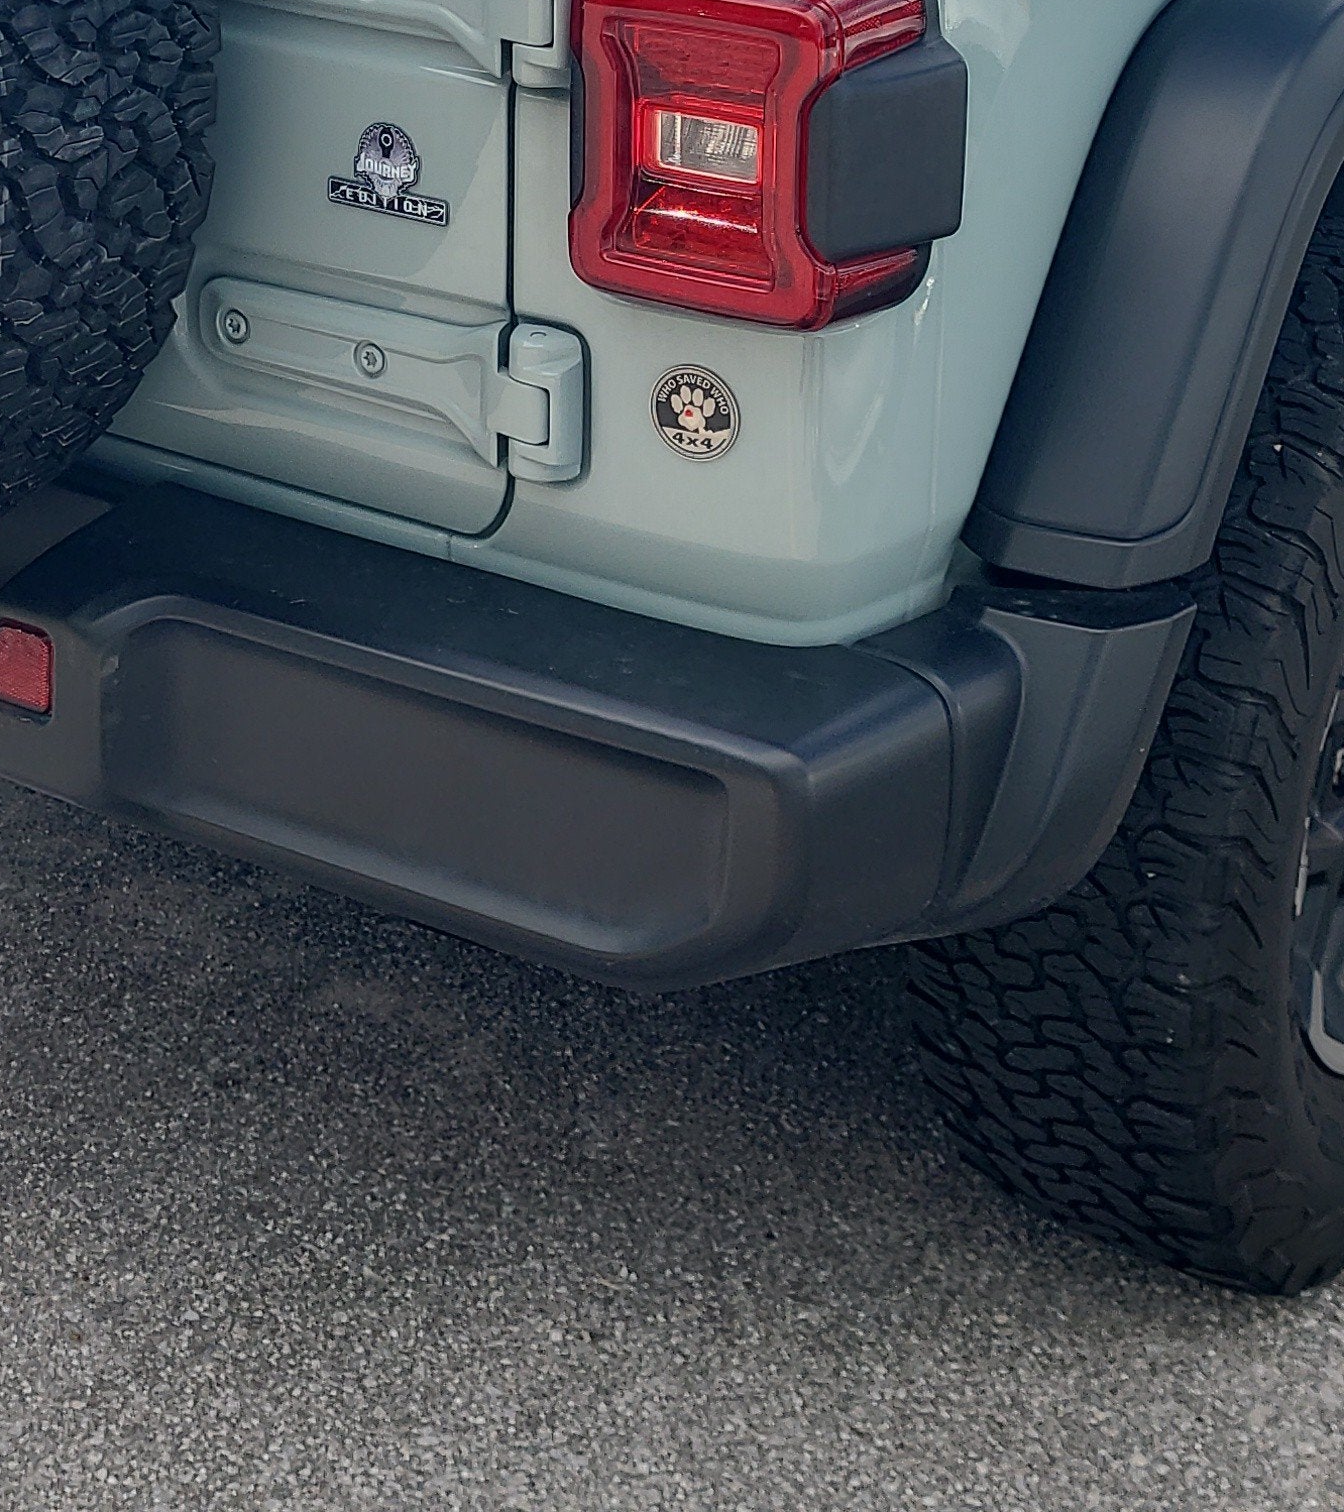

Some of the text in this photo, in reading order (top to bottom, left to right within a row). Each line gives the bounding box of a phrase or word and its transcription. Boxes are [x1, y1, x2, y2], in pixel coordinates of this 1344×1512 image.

[356, 151, 416, 182] JOURNEY
[346, 188, 427, 216] EDITION
[657, 374, 729, 414] WHO SAVED WHO
